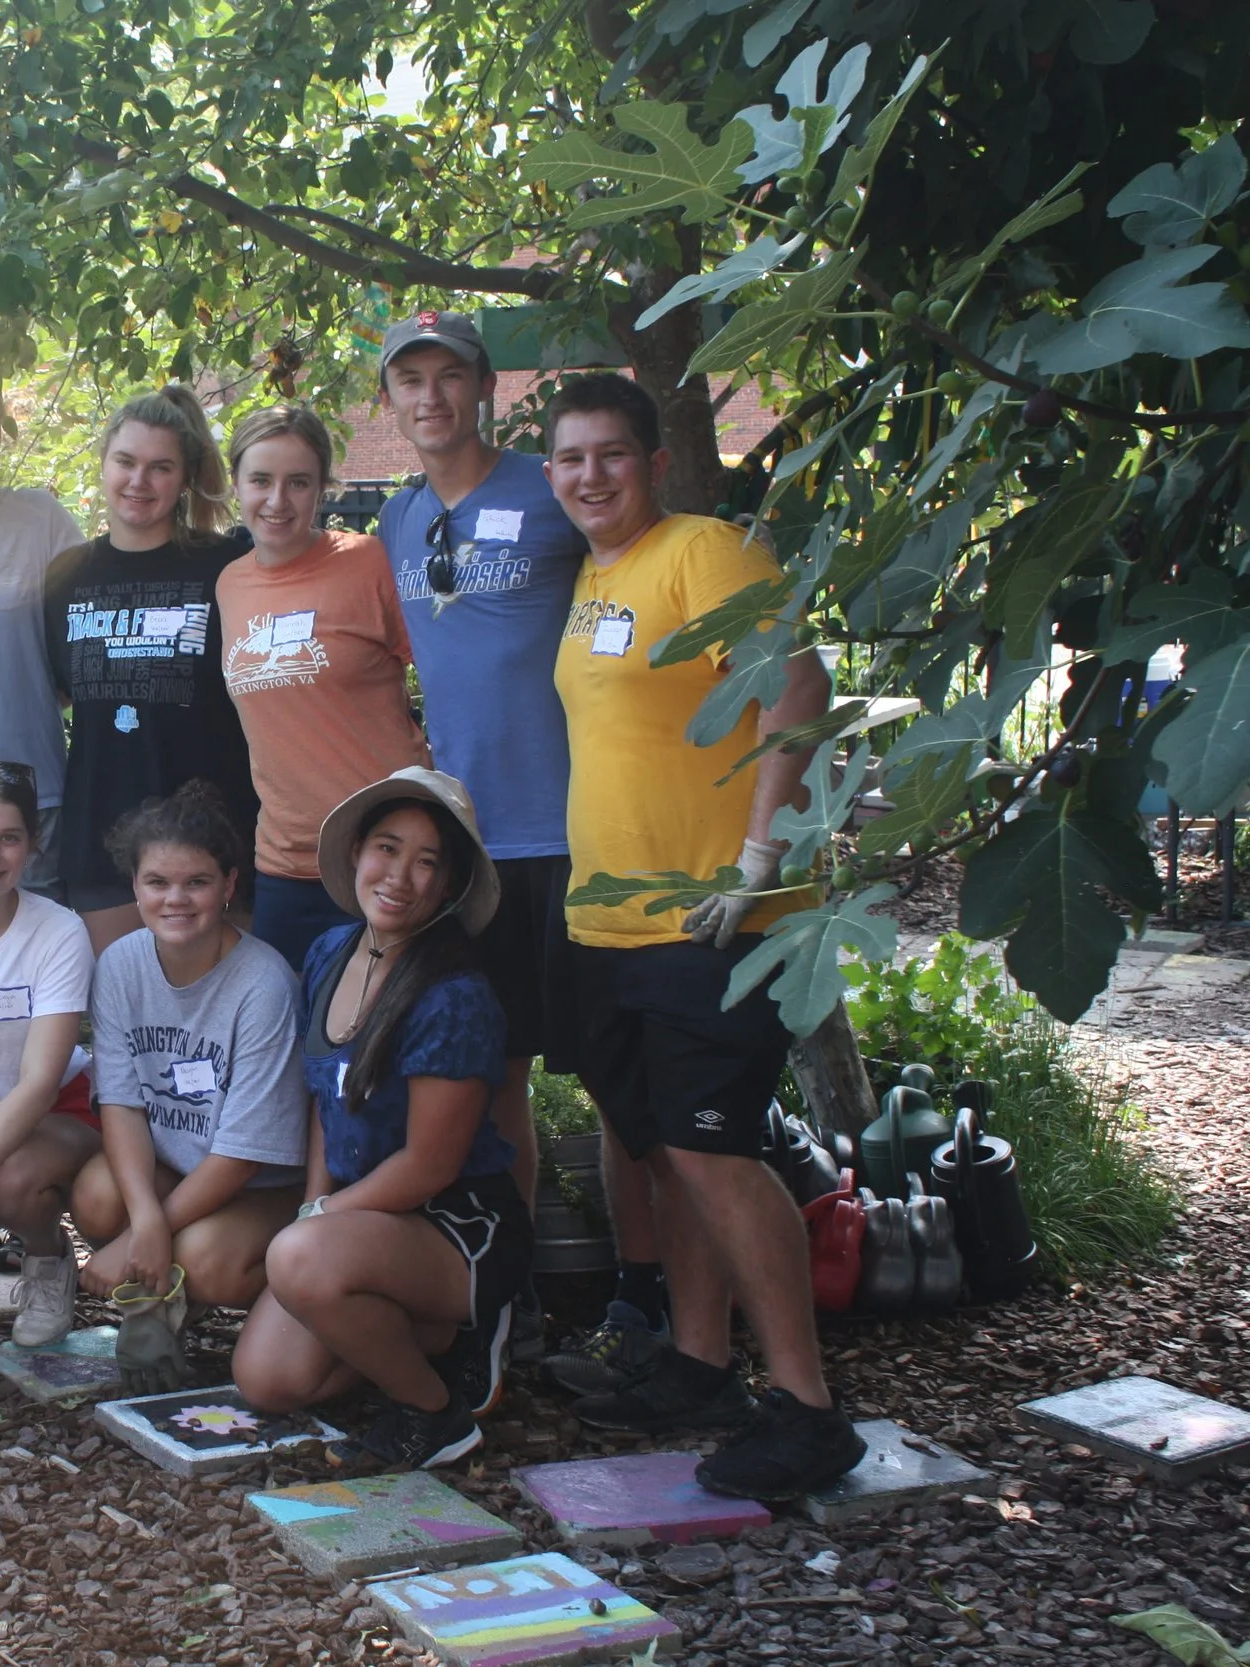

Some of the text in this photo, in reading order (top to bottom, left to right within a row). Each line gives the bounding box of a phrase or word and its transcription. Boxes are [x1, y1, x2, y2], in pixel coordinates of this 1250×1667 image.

[417, 310, 439, 328] B
[453, 557, 532, 594] HASERS
[78, 592, 179, 609] ONG JUMP
[67, 610, 116, 641] TRACK
[104, 637, 125, 647] YOU
[87, 682, 149, 700] HURDLES
[230, 675, 316, 697] LEXINGTON, VA
